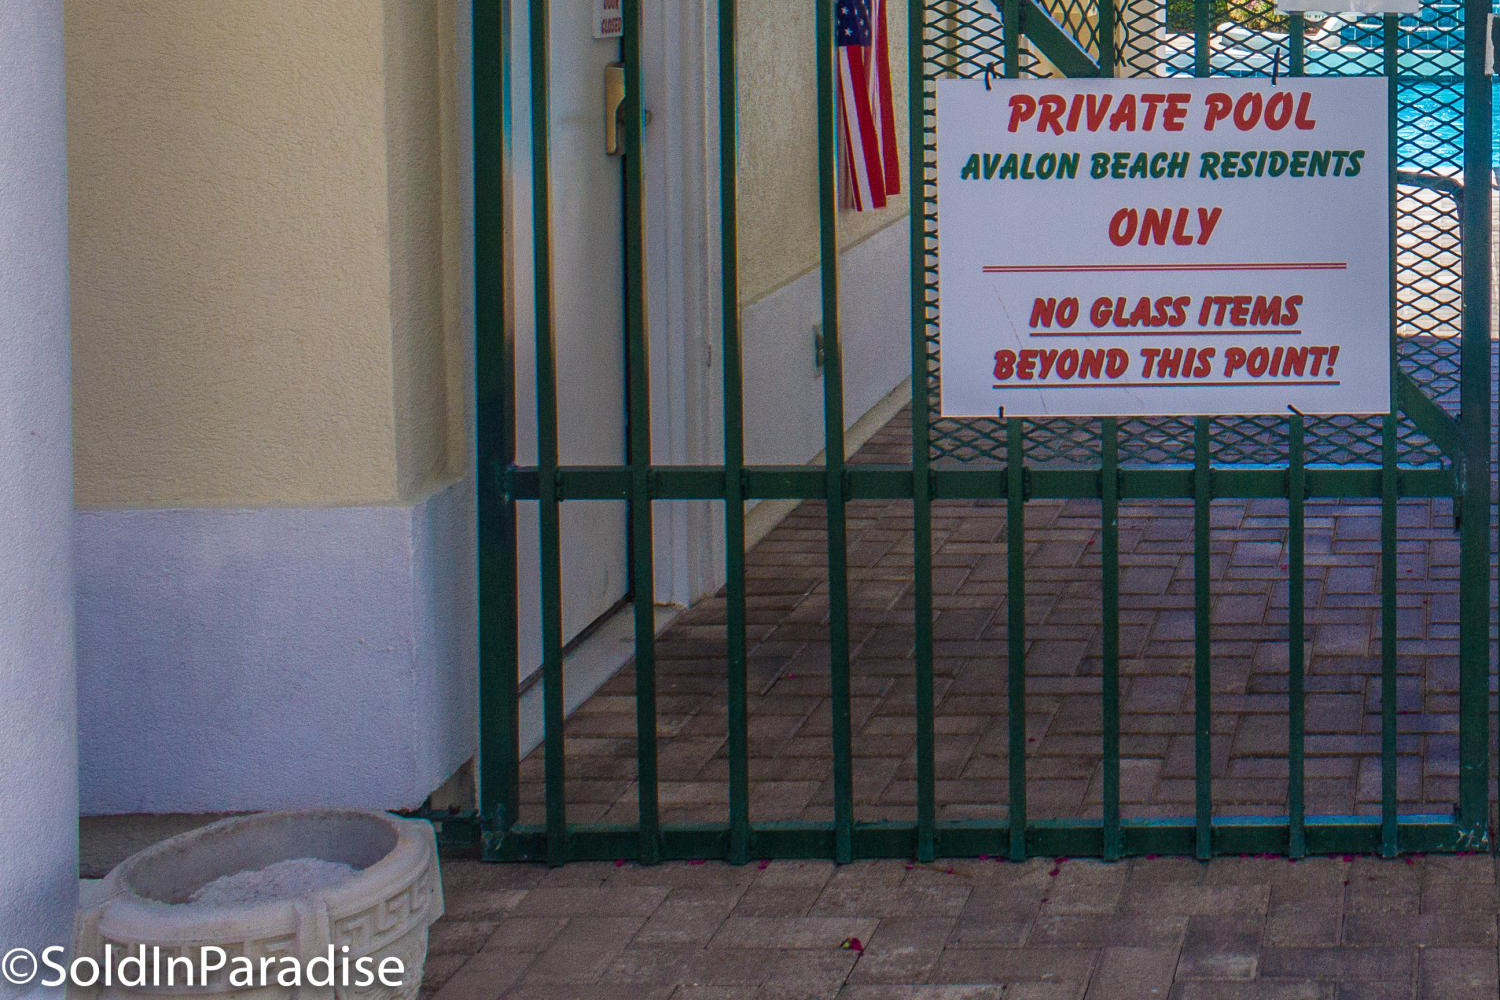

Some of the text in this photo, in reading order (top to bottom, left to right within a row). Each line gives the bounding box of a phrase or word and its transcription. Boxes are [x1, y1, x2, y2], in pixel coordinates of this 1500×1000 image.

[1006, 91, 1317, 136] PRIVATE POOL
[960, 149, 1366, 181] AVALON BEACH RESIDENTS
[1107, 206, 1223, 247] ONLY
[1028, 294, 1304, 329] NO GLASS ITEMS
[992, 345, 1341, 381] BEYOND THIS POINT!
